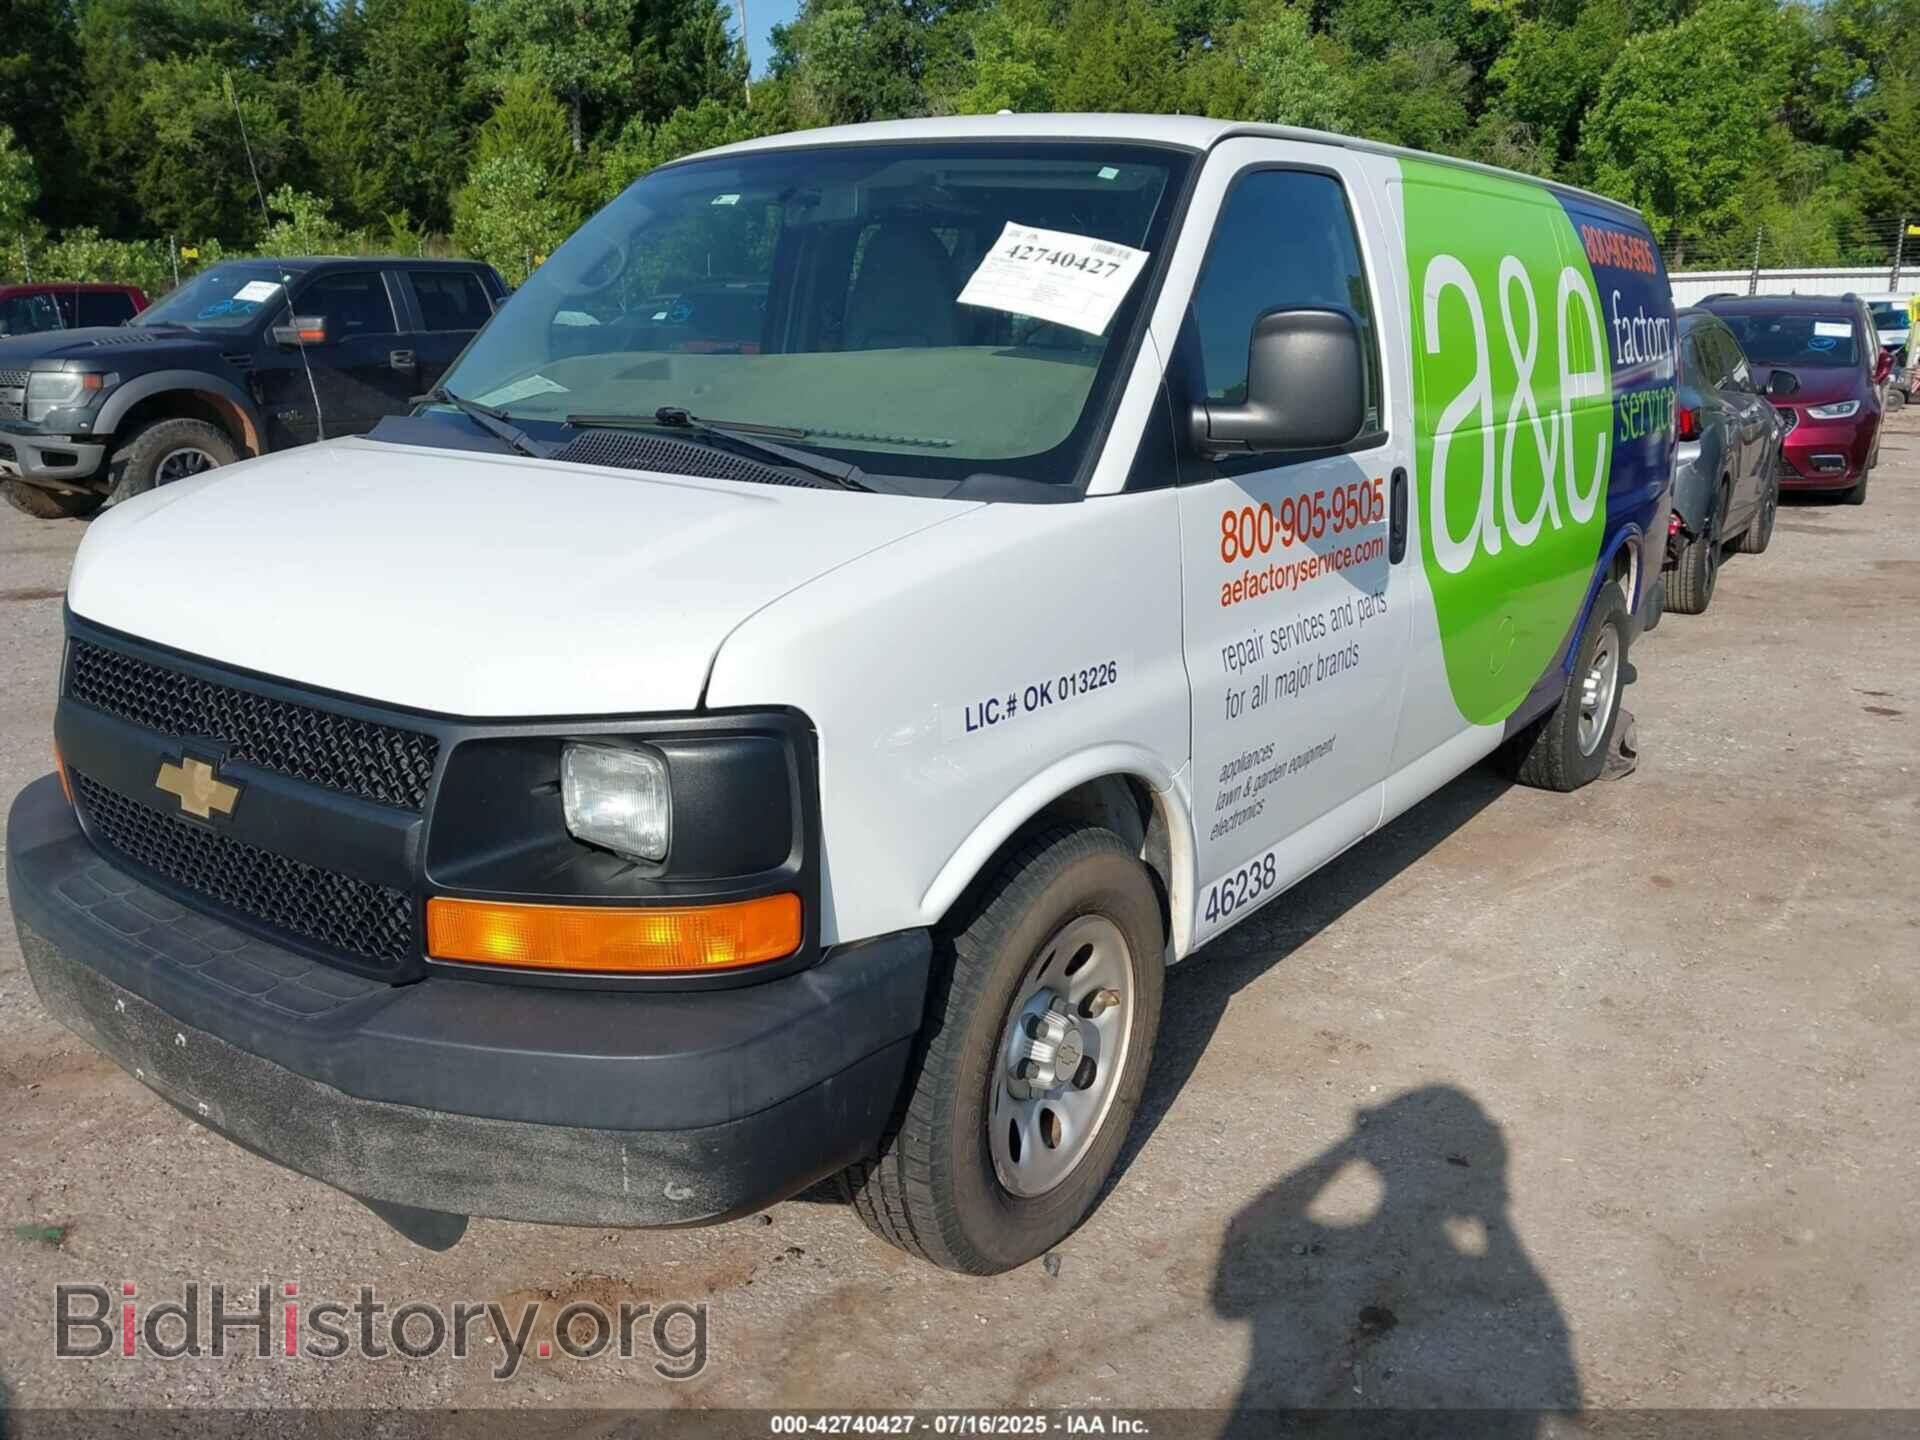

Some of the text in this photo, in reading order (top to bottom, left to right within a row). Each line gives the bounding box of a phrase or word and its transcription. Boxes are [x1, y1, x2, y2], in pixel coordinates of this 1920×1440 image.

[1006, 244, 1120, 279] 42740427
[1612, 289, 1674, 379] factory
[1423, 254, 1606, 574] a&e
[1221, 536, 1384, 607] aefactoryservice.com
[1222, 591, 1388, 674] repair services and parts
[965, 660, 1117, 732] LIC.# OK 013226
[1225, 640, 1360, 720] for all major brands
[1215, 734, 1337, 812] lawn & garden equipment
[1219, 742, 1275, 784] appliances
[1210, 798, 1265, 841] electronics
[1205, 852, 1276, 924] 46238
